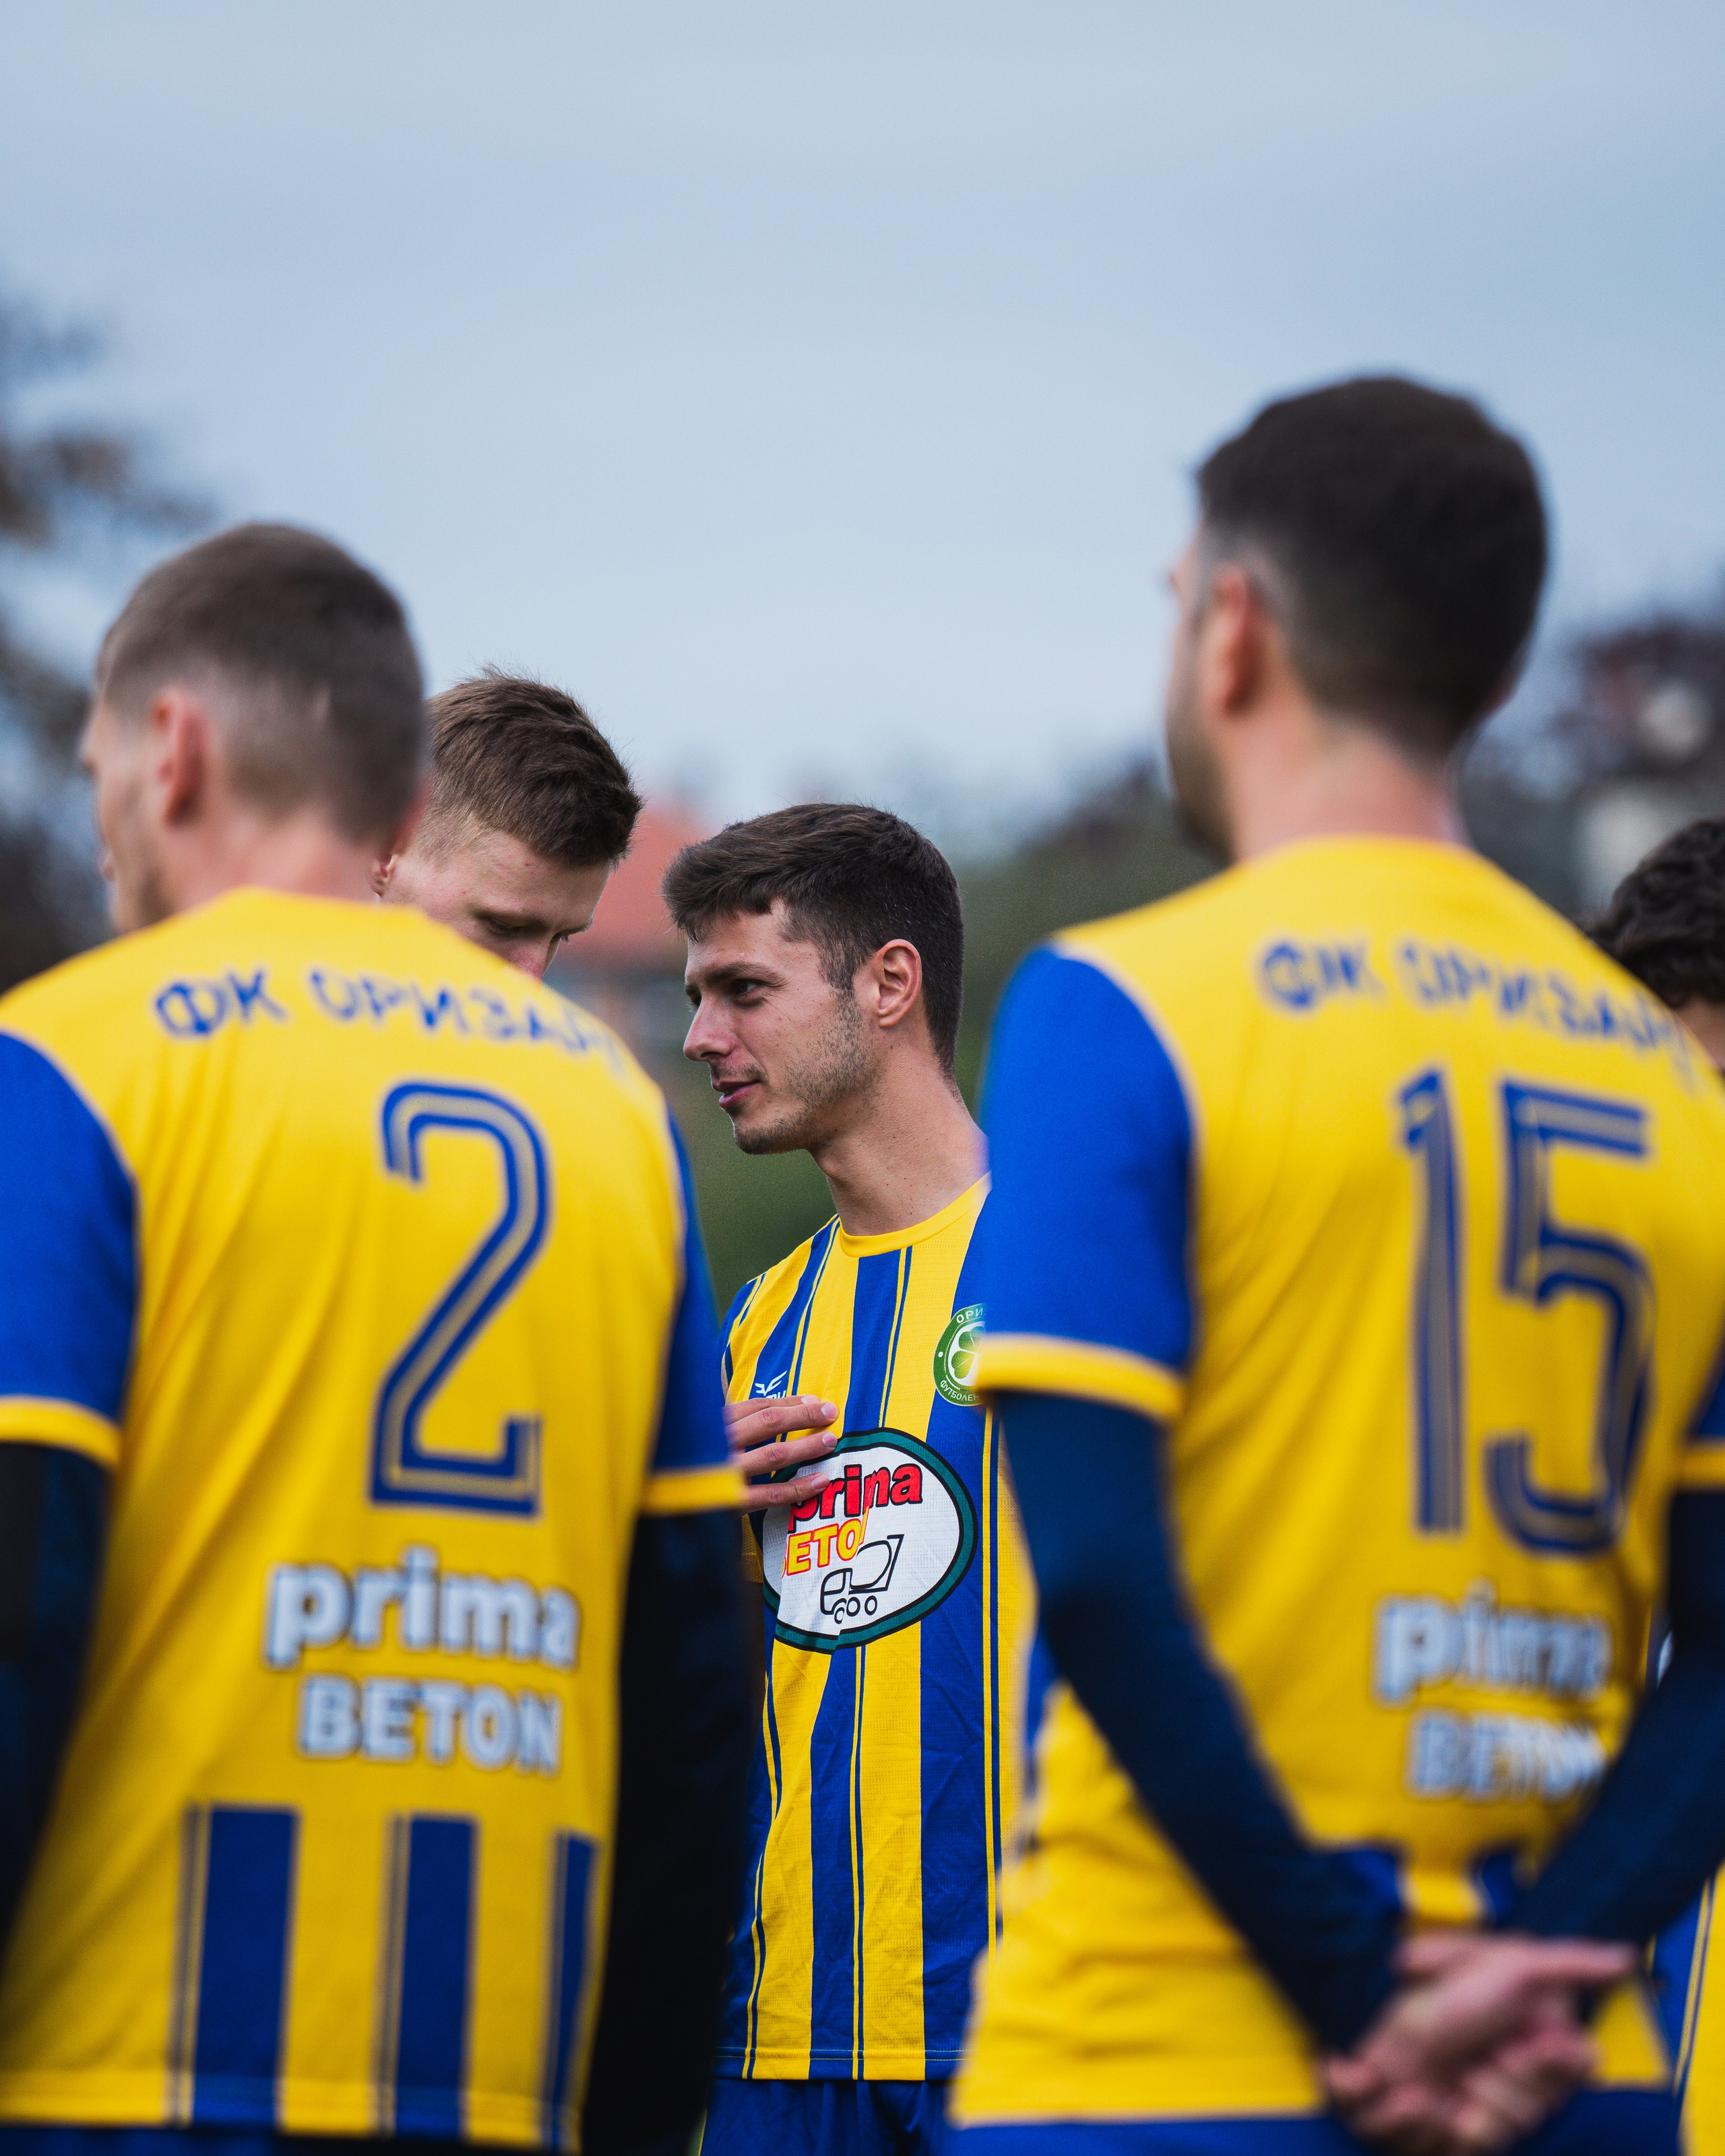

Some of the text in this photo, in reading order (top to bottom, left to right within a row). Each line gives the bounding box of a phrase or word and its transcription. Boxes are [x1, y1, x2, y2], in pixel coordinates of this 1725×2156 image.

[152, 967, 288, 1041] ФК
[367, 1078, 549, 1519] 2
[956, 1307, 984, 1324] ОРИ
[1391, 1067, 1656, 1556] 15
[265, 1544, 579, 1671] prima
[297, 1674, 561, 1776] BETON
